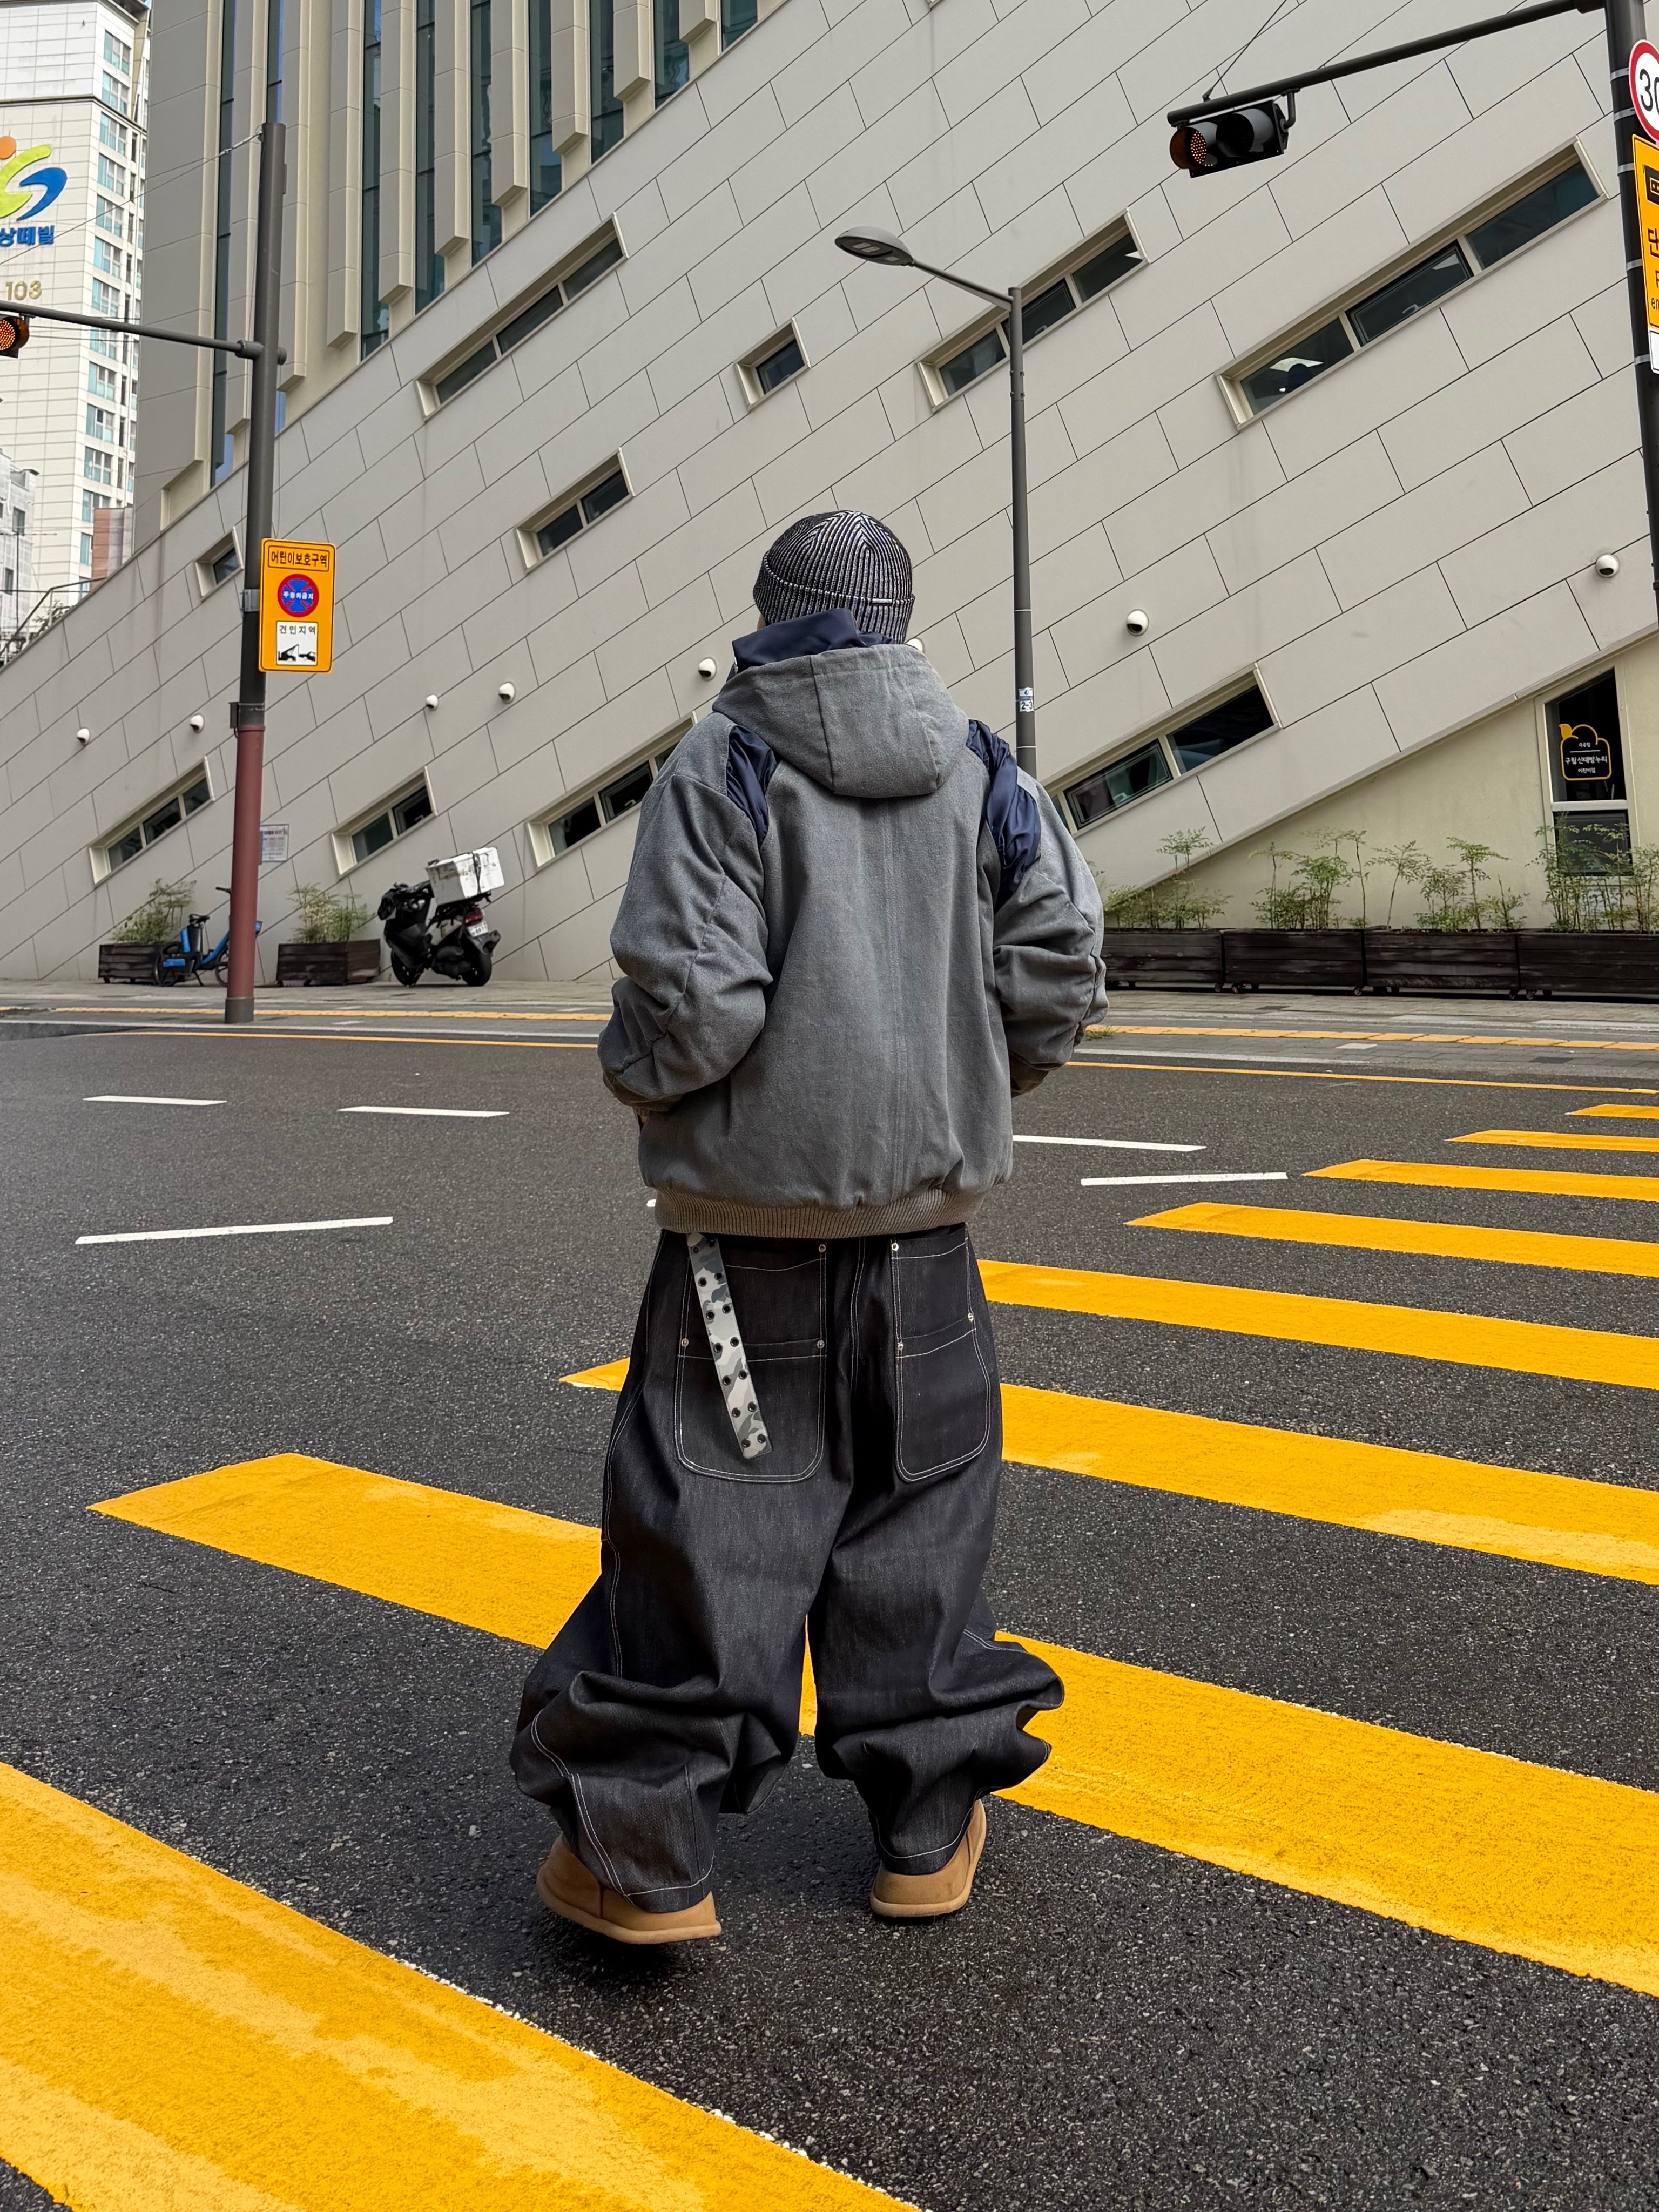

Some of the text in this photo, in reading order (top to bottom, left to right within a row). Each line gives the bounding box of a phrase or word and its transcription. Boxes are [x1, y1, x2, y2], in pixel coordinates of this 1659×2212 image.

[5, 280, 42, 301] 103
[271, 550, 327, 567] 어린이보호구역
[279, 625, 316, 635] 견인지역
[1021, 702, 1033, 710] 2-3
